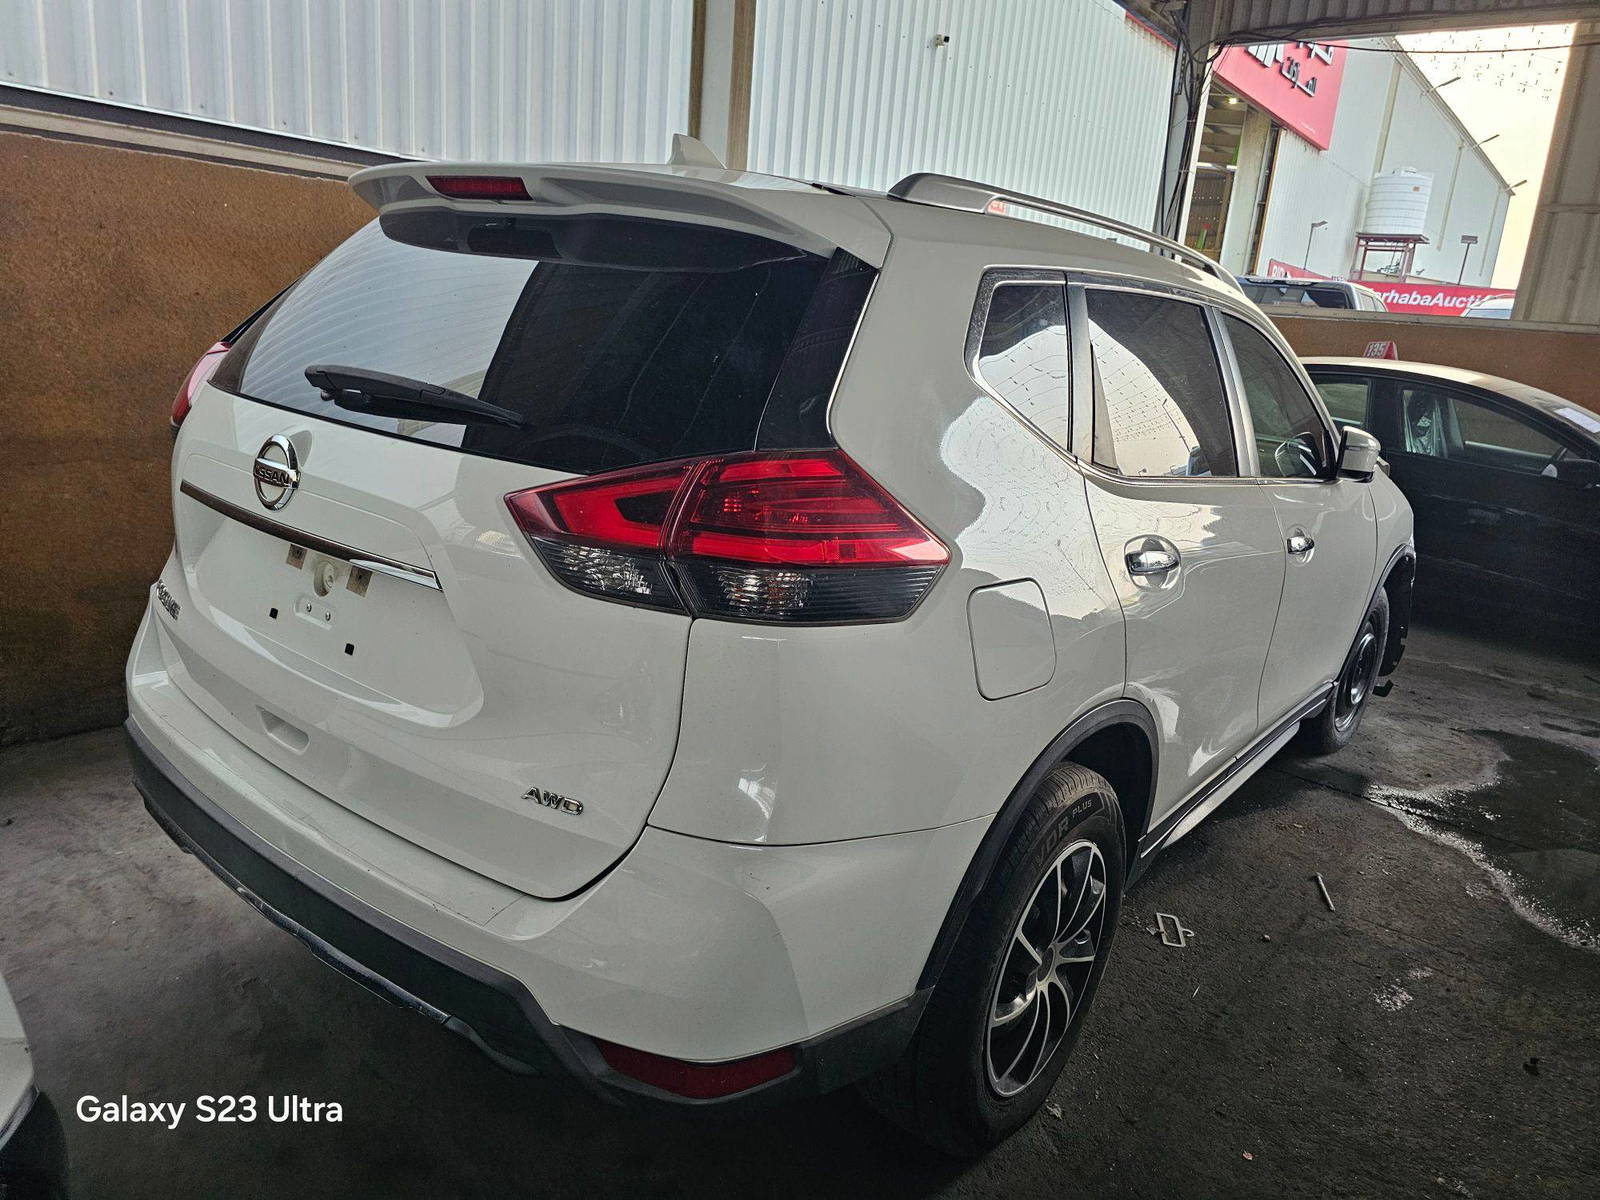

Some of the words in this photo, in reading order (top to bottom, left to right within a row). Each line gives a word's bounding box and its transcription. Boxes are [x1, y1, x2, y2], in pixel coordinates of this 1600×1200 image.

[1367, 342, 1387, 357] 135
[521, 786, 584, 815] AWD
[1072, 799, 1092, 818] PLUS
